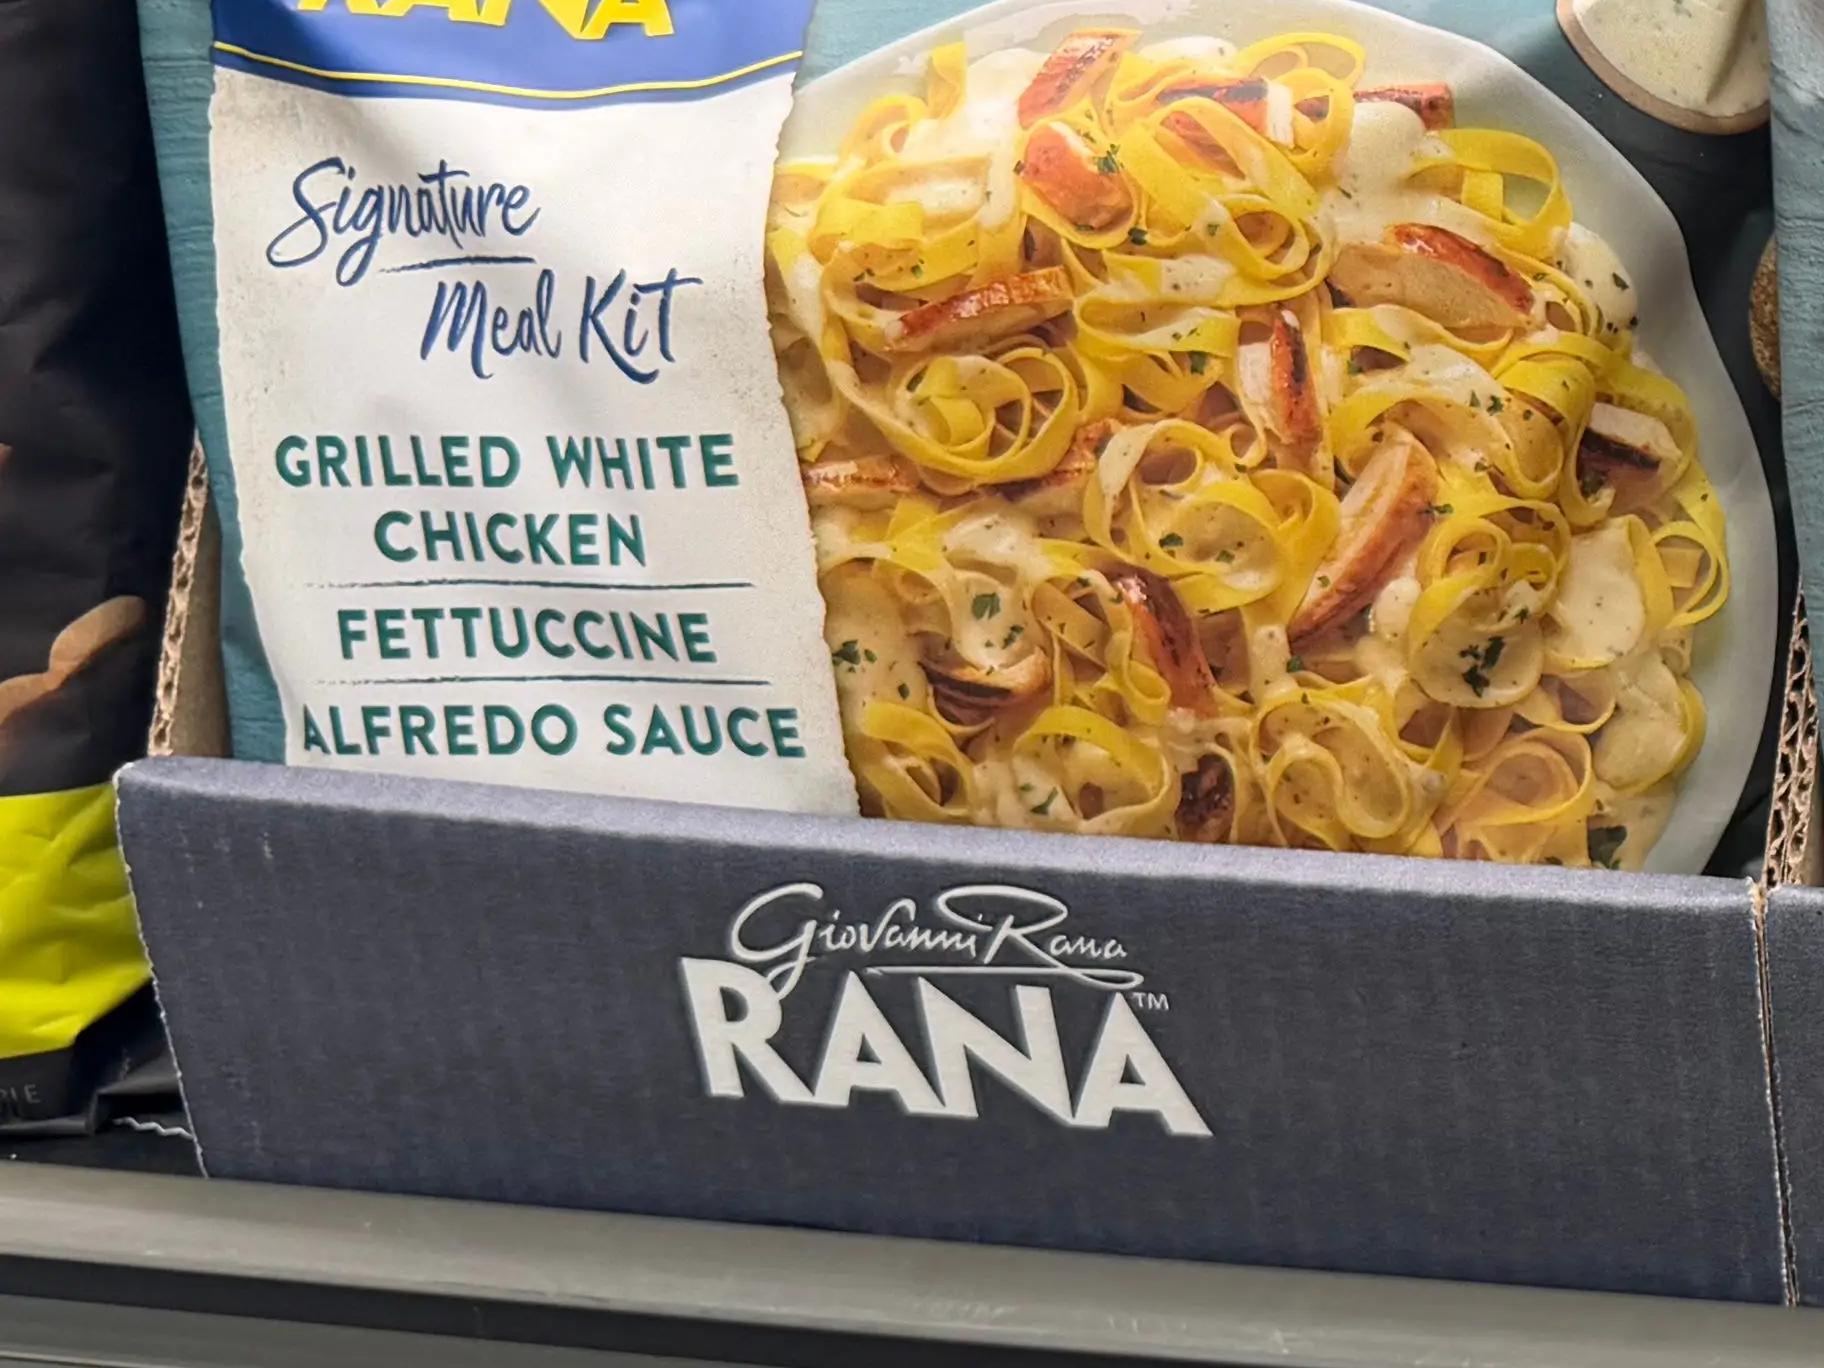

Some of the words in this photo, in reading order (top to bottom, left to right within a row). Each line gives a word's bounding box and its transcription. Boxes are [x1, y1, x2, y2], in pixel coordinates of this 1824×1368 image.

[267, 157, 541, 287] Signature
[420, 268, 561, 379] Meal
[580, 268, 704, 381] Kit
[275, 435, 521, 488] GRILLED
[547, 433, 740, 488] WHITE
[375, 511, 646, 567] CHICKEN
[339, 609, 718, 663] FETTUCCINE
[303, 704, 578, 756] ALFREDO
[604, 705, 807, 758] SAUCE
[680, 956, 1214, 1136] RANA
